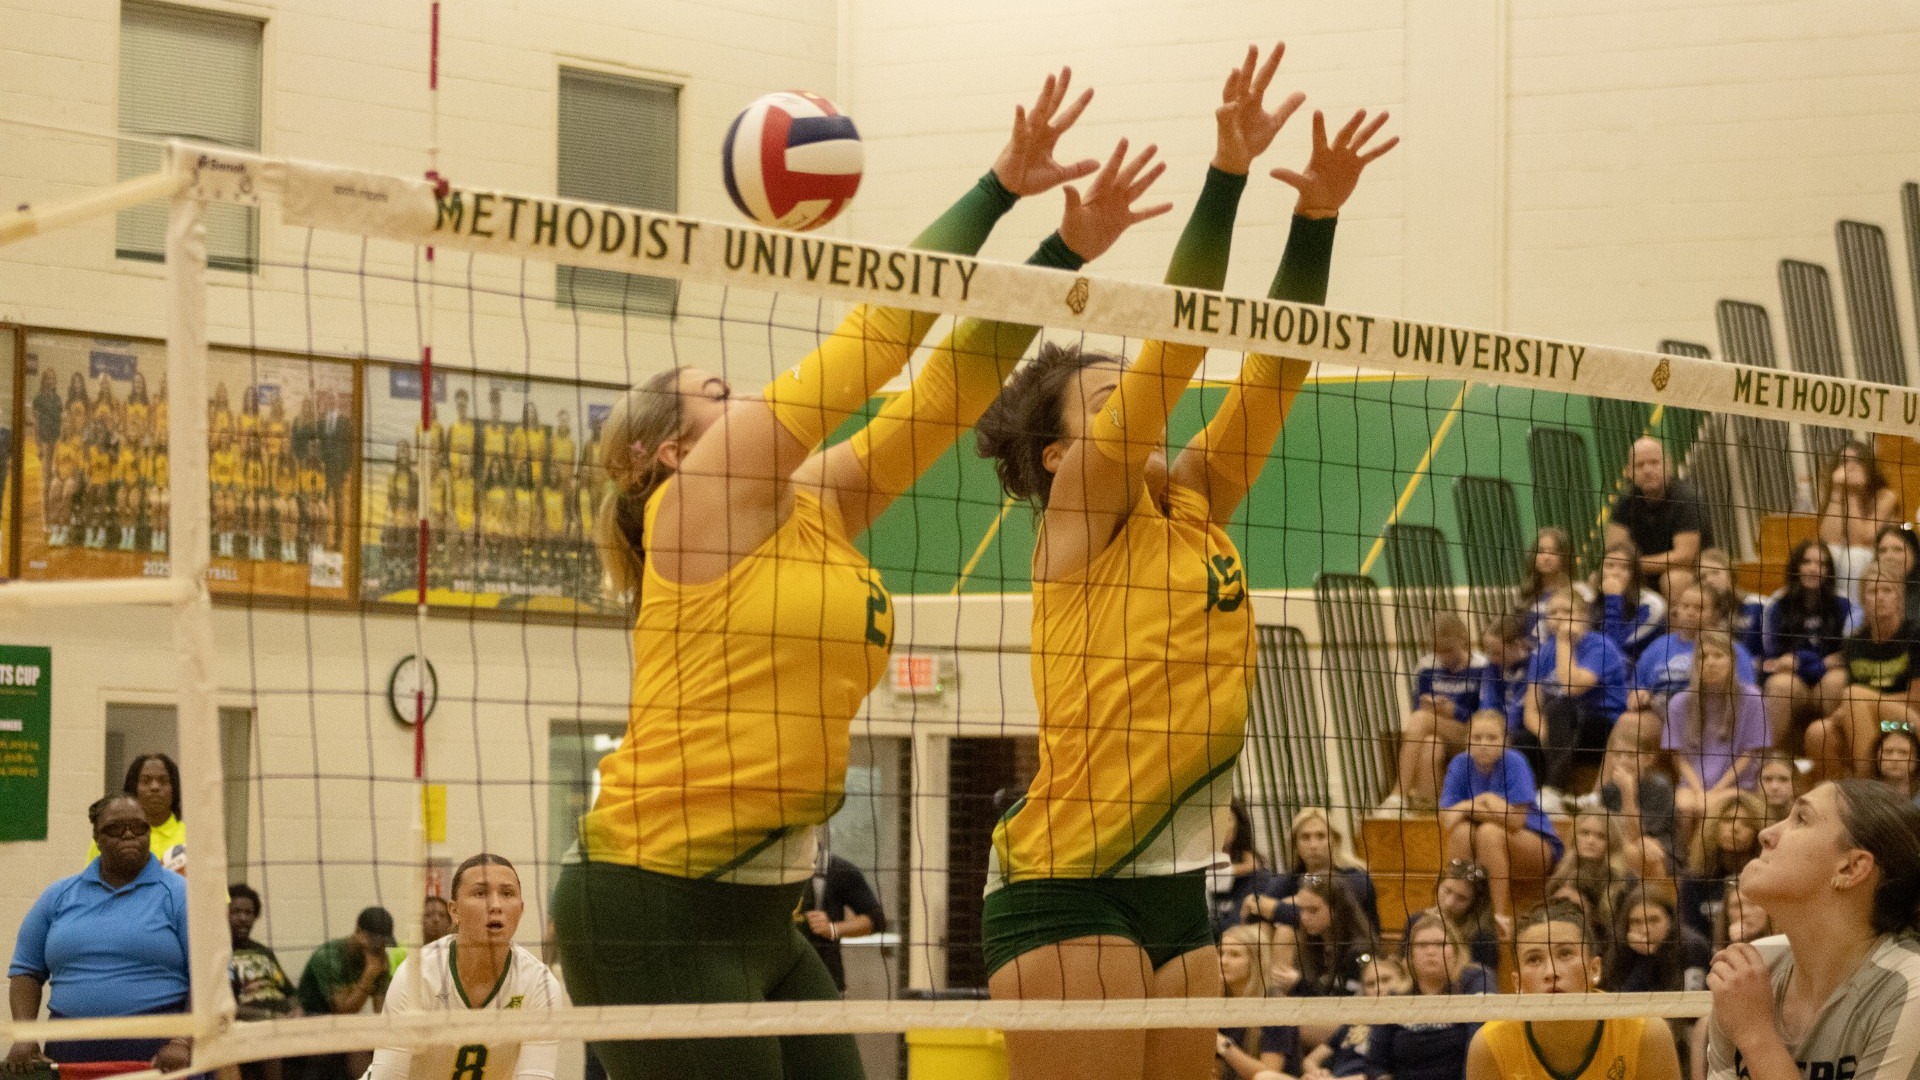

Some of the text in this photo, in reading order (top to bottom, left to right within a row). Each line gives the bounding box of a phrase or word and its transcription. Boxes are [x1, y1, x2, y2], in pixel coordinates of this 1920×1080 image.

[434, 190, 978, 300] METHODIST UNIVERSITY
[1172, 289, 1587, 381] METHODIST UNIVERSITY
[1733, 367, 1920, 425] METHODIST U
[15, 664, 41, 687] CUP
